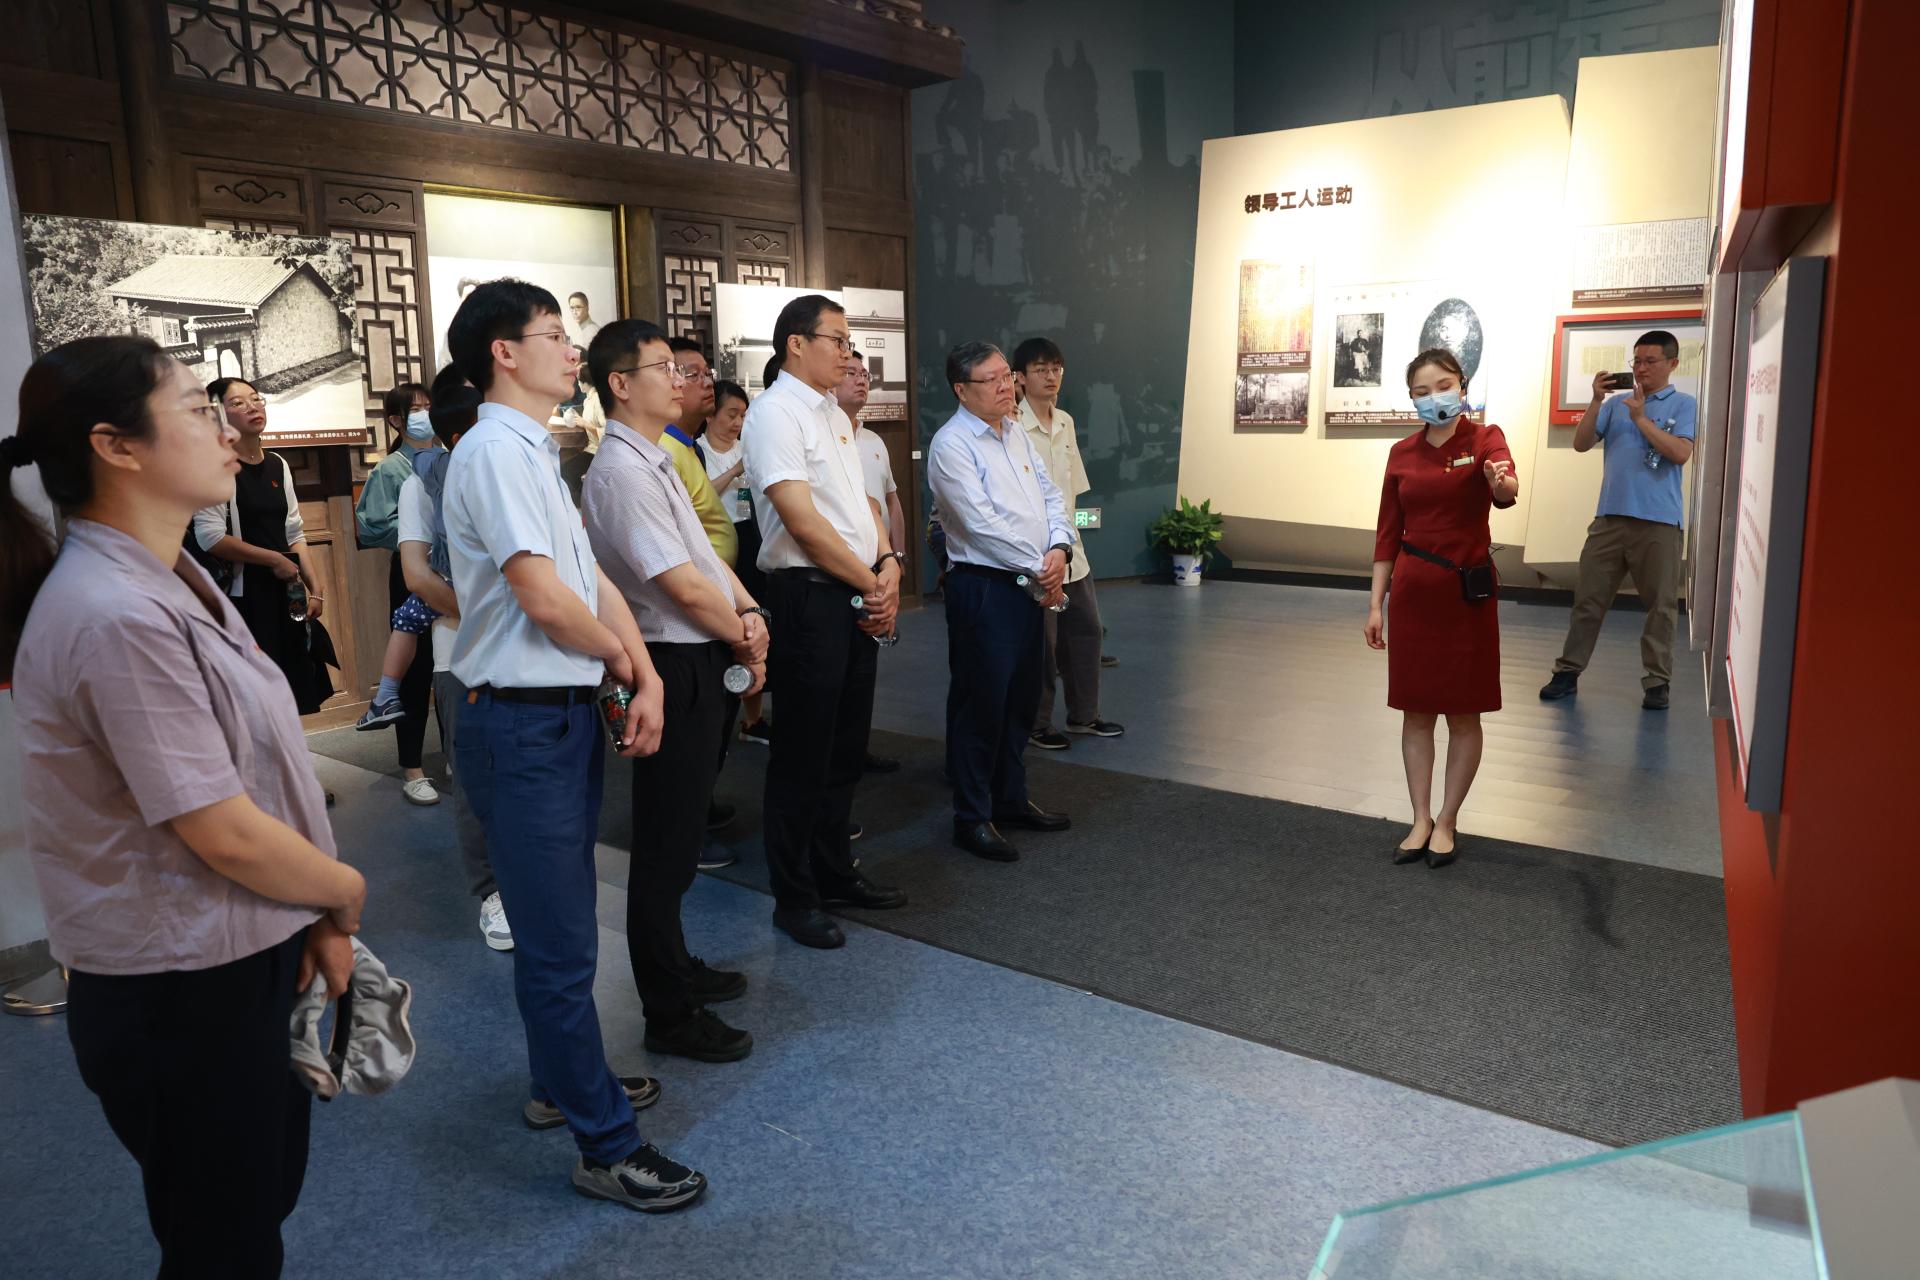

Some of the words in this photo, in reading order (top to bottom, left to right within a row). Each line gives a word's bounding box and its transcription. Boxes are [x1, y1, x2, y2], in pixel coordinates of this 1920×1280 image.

[1244, 184, 1353, 214] 领导工人运动
